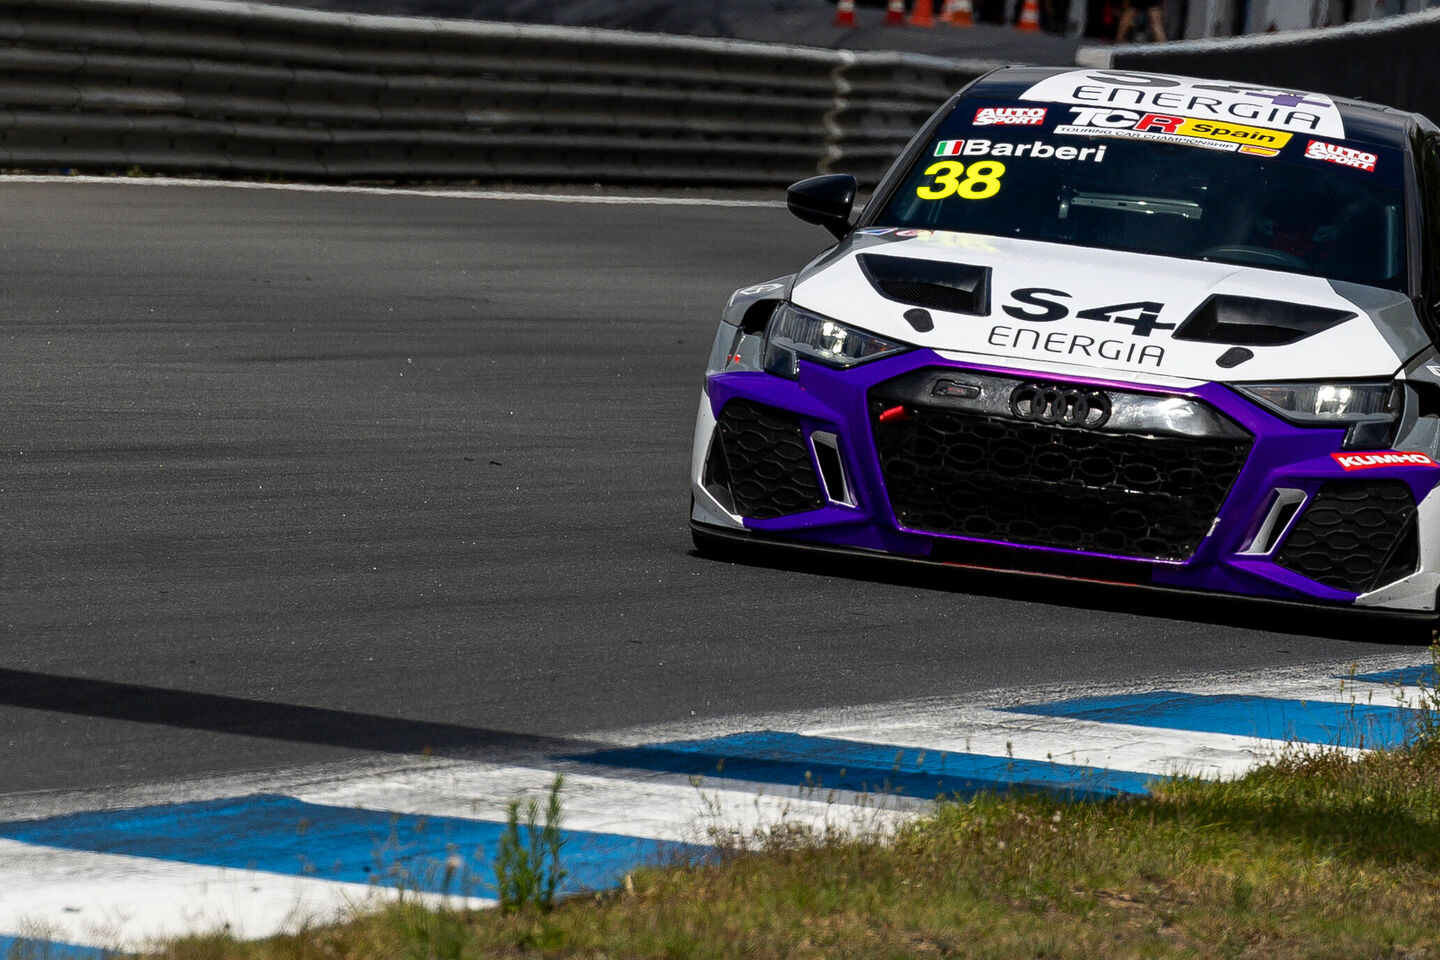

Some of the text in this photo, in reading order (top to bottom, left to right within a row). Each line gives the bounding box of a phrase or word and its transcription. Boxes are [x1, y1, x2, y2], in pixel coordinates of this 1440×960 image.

[976, 107, 1046, 117] AUTO
[1072, 84, 1321, 130] ENERGIA
[972, 115, 1045, 126] SPORT
[1069, 106, 1276, 143] TCR Spain
[1061, 127, 1234, 149] TOURING CAR CHAMPIONSHIP
[962, 139, 1107, 162] Barberi
[1304, 149, 1374, 169] SPORT
[1308, 141, 1377, 163] AUTO
[916, 160, 1006, 200] 38
[1001, 287, 1177, 337] S4
[987, 325, 1166, 367] ENERGIA
[1337, 454, 1432, 467] KUMHO
